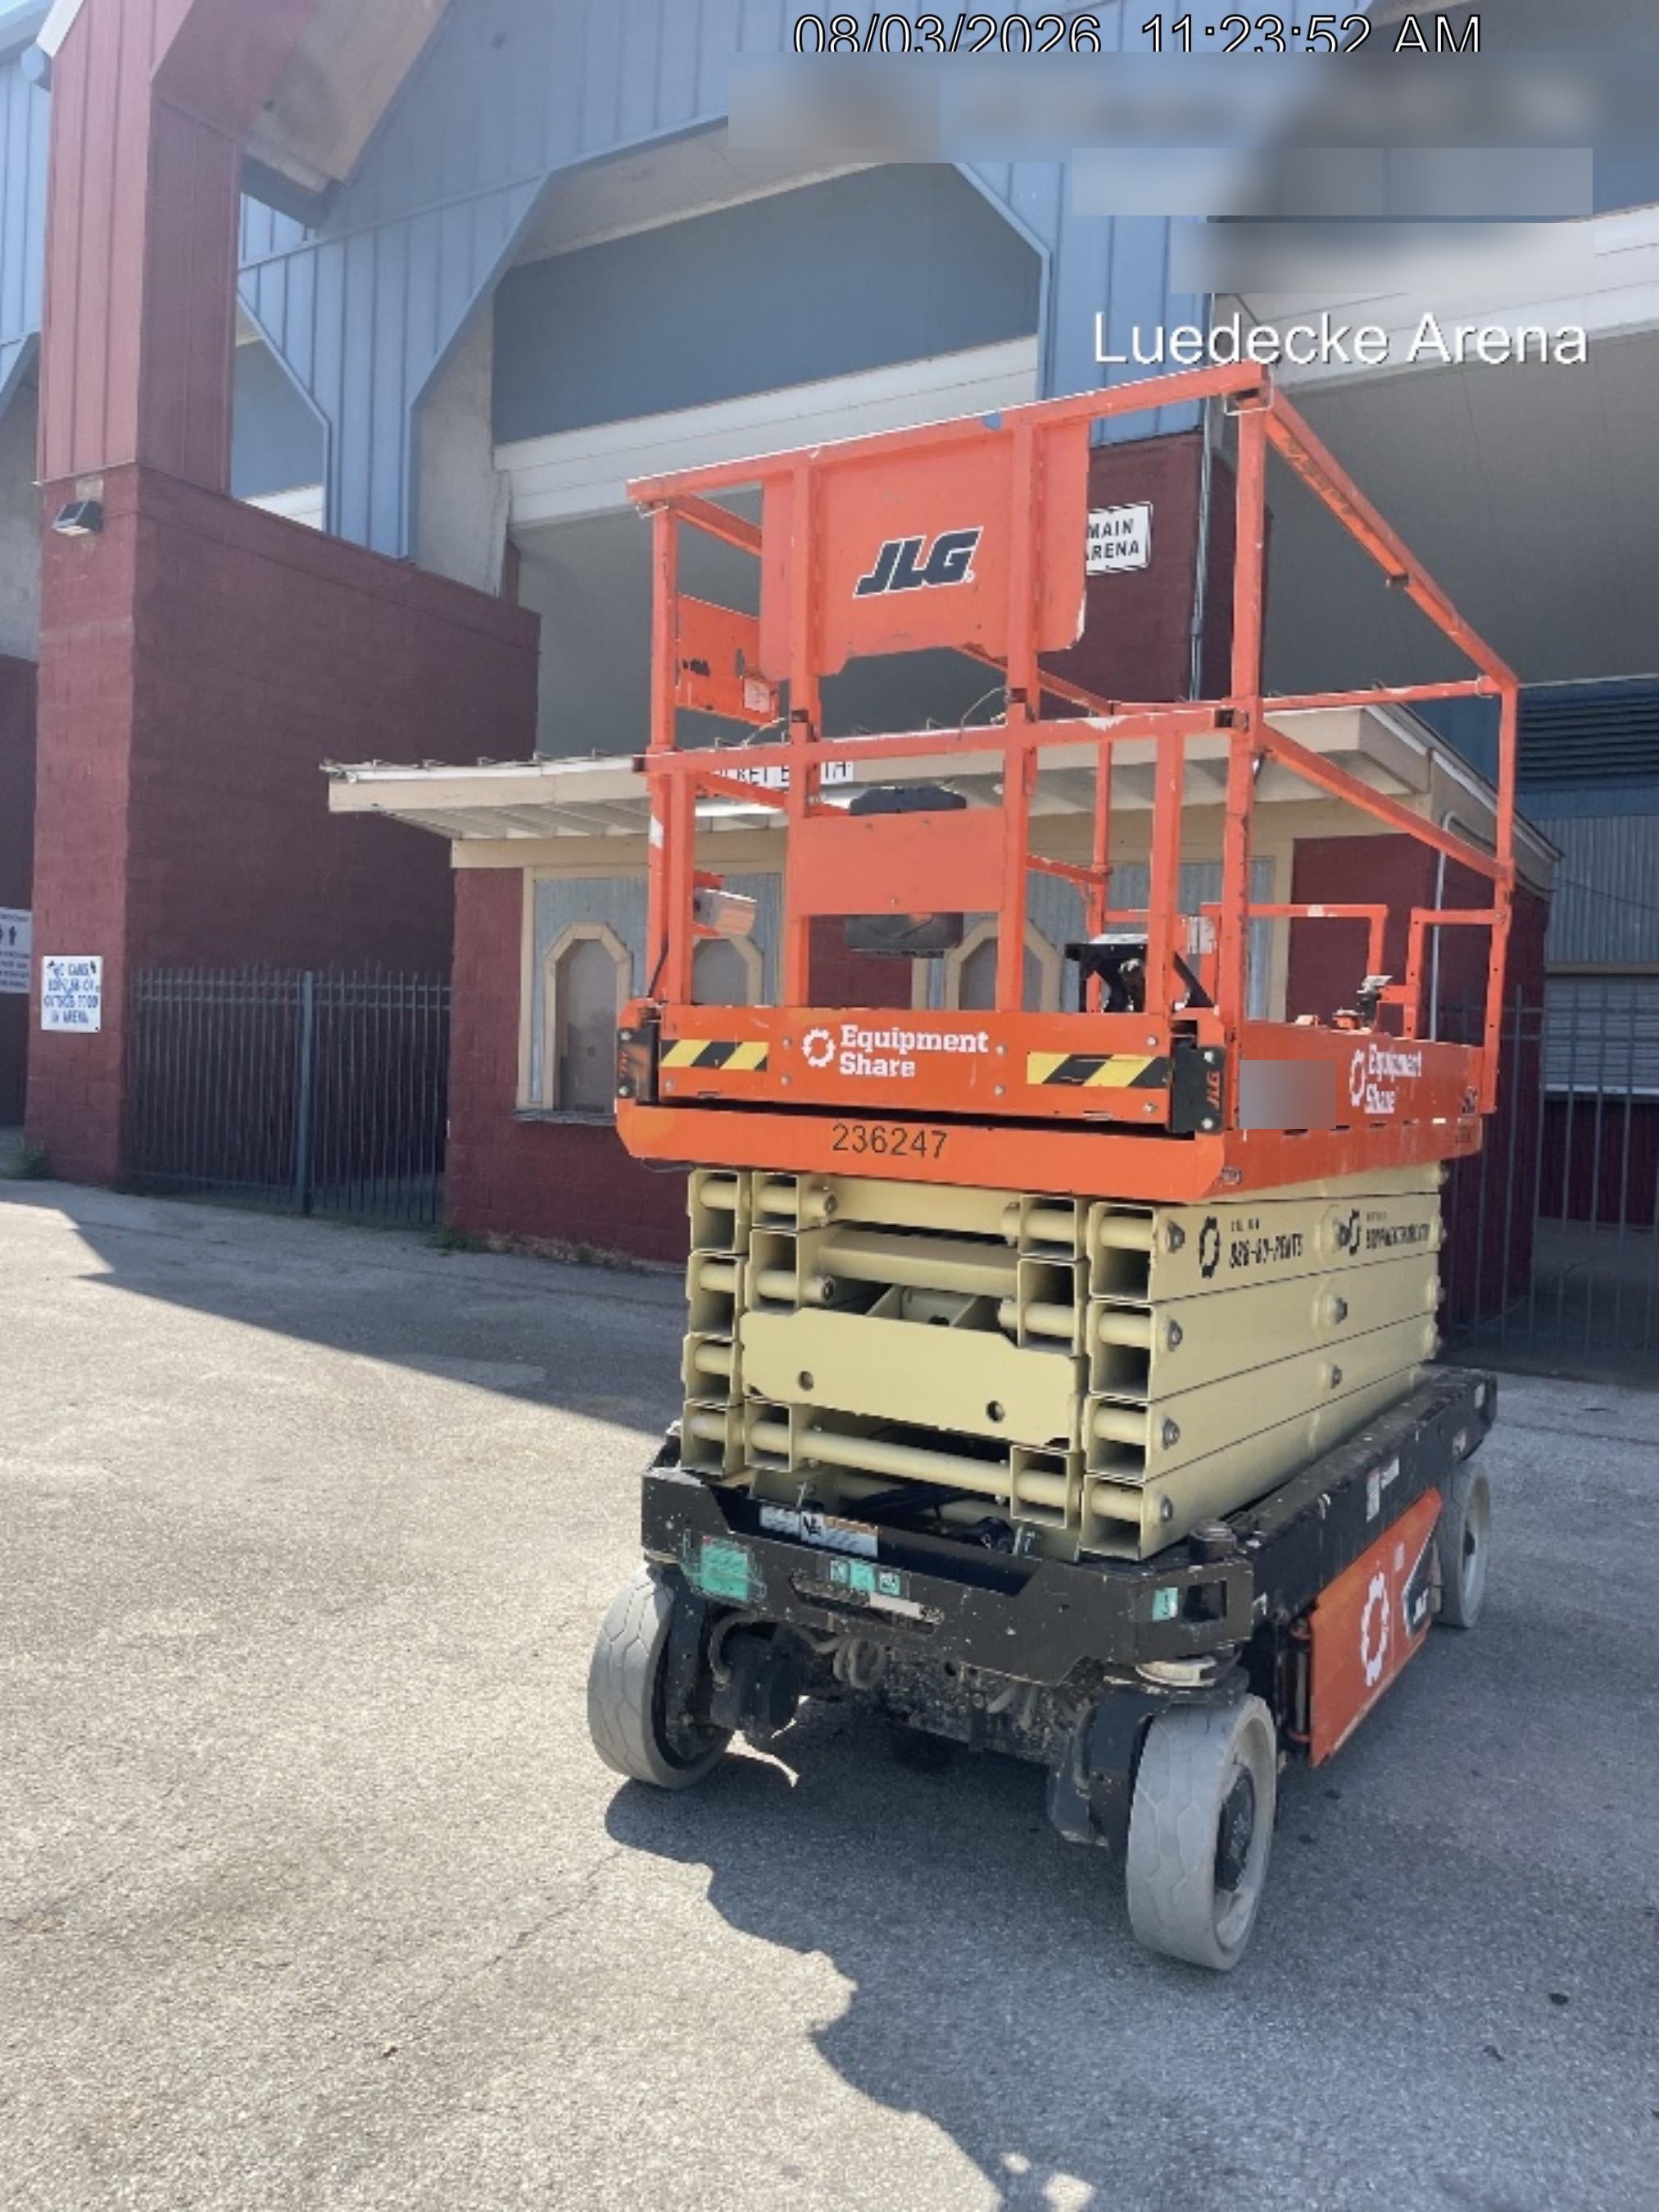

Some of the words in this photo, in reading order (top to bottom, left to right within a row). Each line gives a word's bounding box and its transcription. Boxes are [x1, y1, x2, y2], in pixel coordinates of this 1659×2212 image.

[1087, 519, 1134, 539] MAIN
[853, 525, 984, 600] JLG
[1086, 540, 1140, 561] RENA
[840, 1024, 990, 1054] Equipment
[839, 1051, 915, 1077] Share
[832, 1122, 947, 1158] 236247
